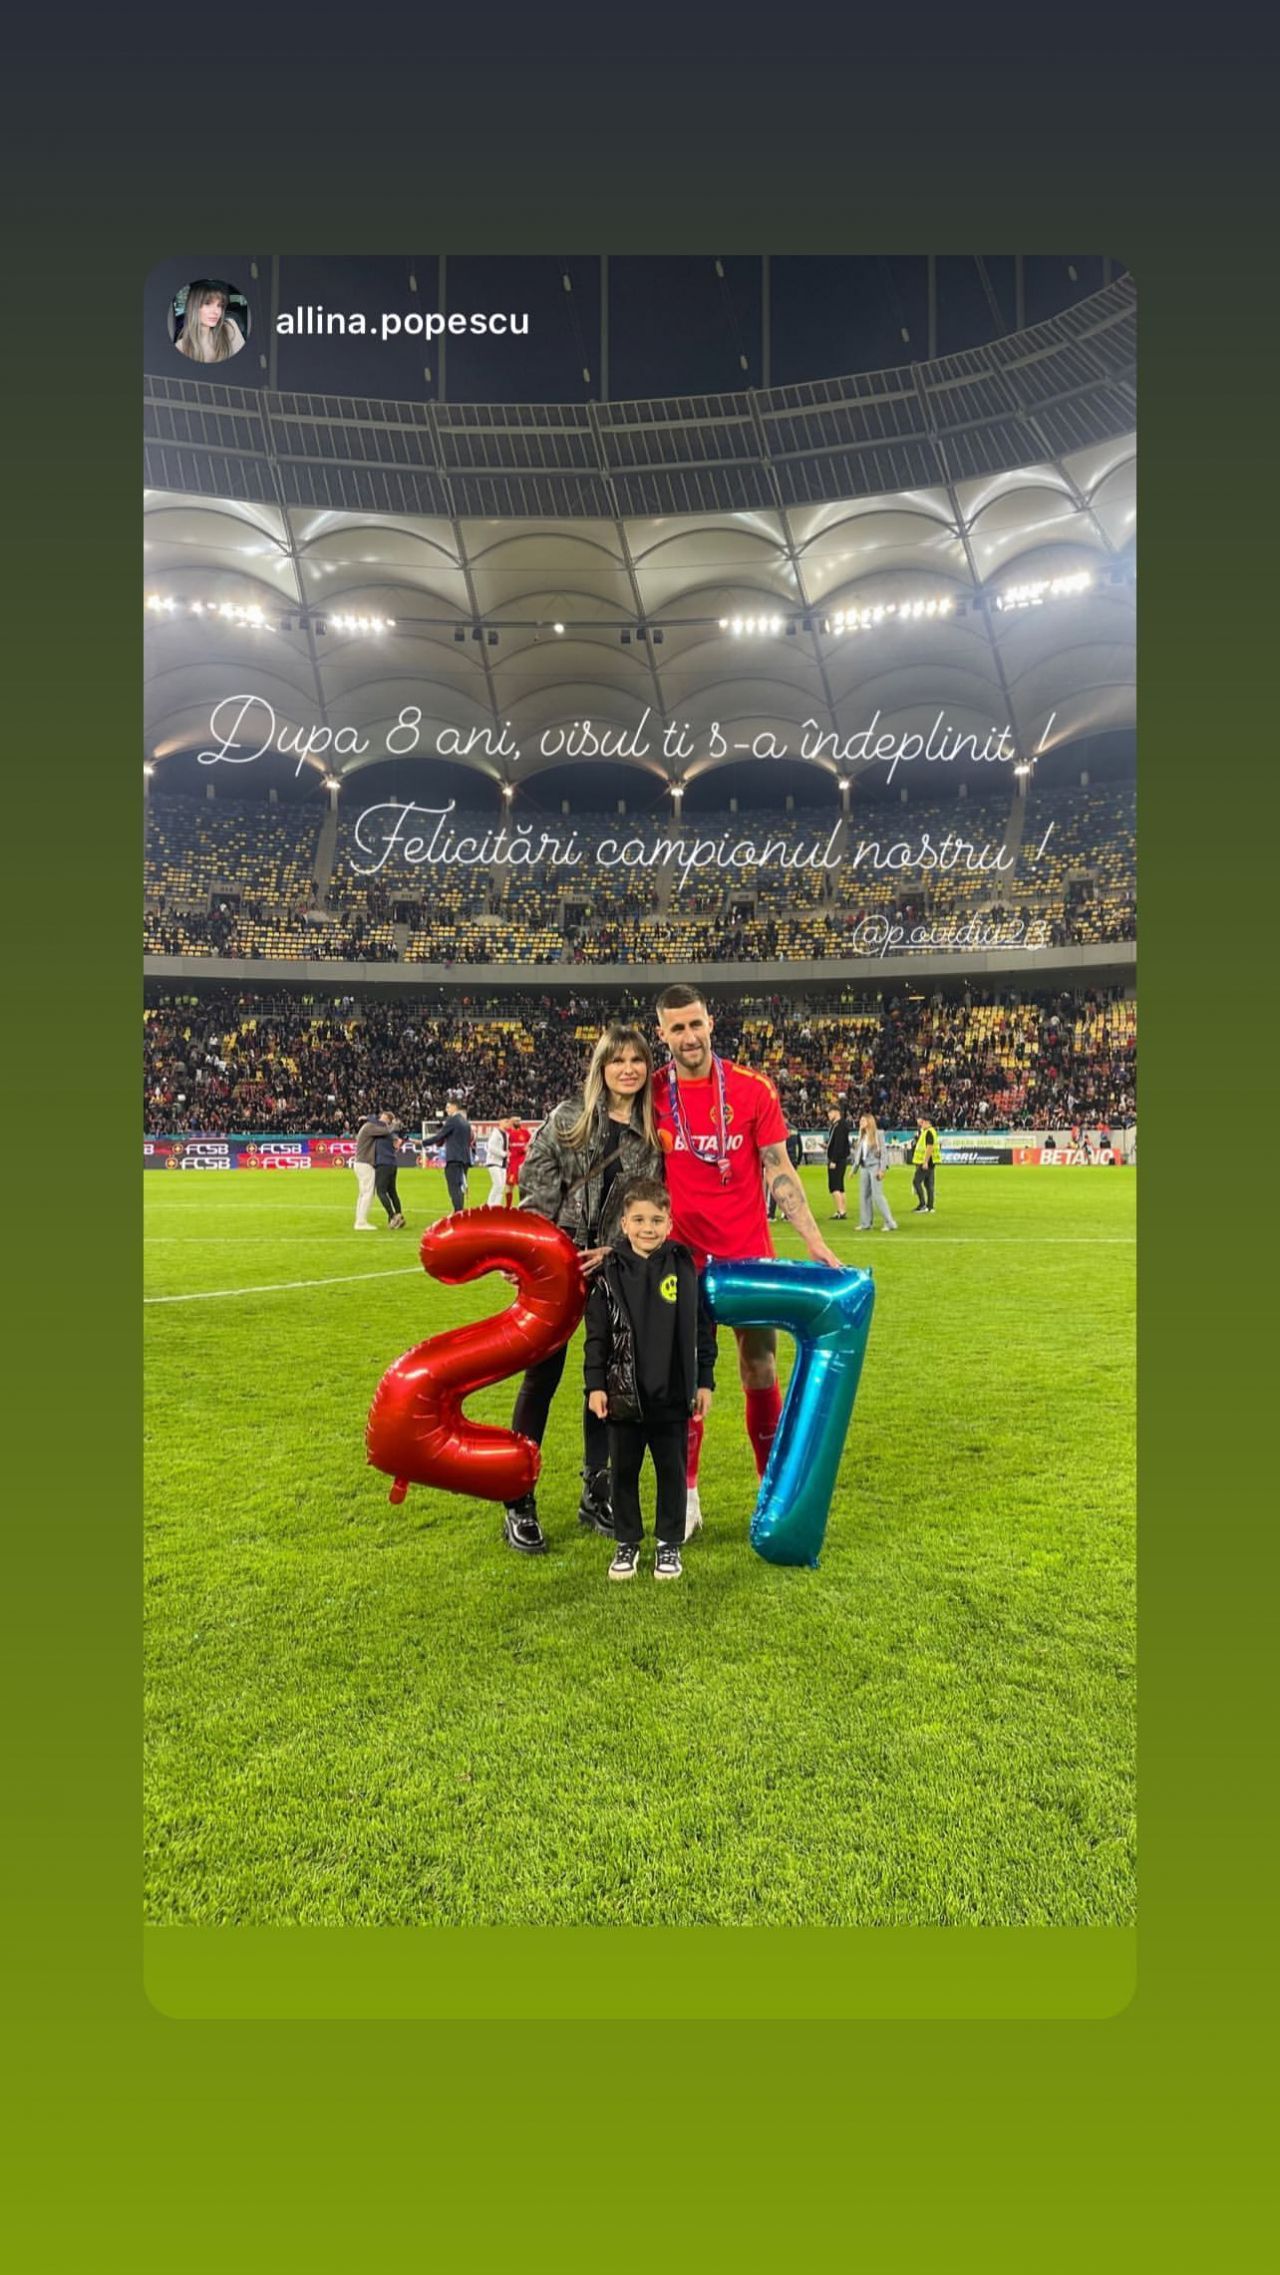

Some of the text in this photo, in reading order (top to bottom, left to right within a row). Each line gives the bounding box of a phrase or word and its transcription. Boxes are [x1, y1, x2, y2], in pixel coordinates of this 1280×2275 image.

[185, 1143, 230, 1155] FCSB
[258, 1142, 302, 1155] FCSB
[327, 1142, 357, 1155] FCS
[673, 1133, 744, 1151] BTAO
[180, 1156, 312, 1170] FCSB FCSB
[364, 1205, 587, 1504] 2
[703, 1254, 876, 1568] 7
